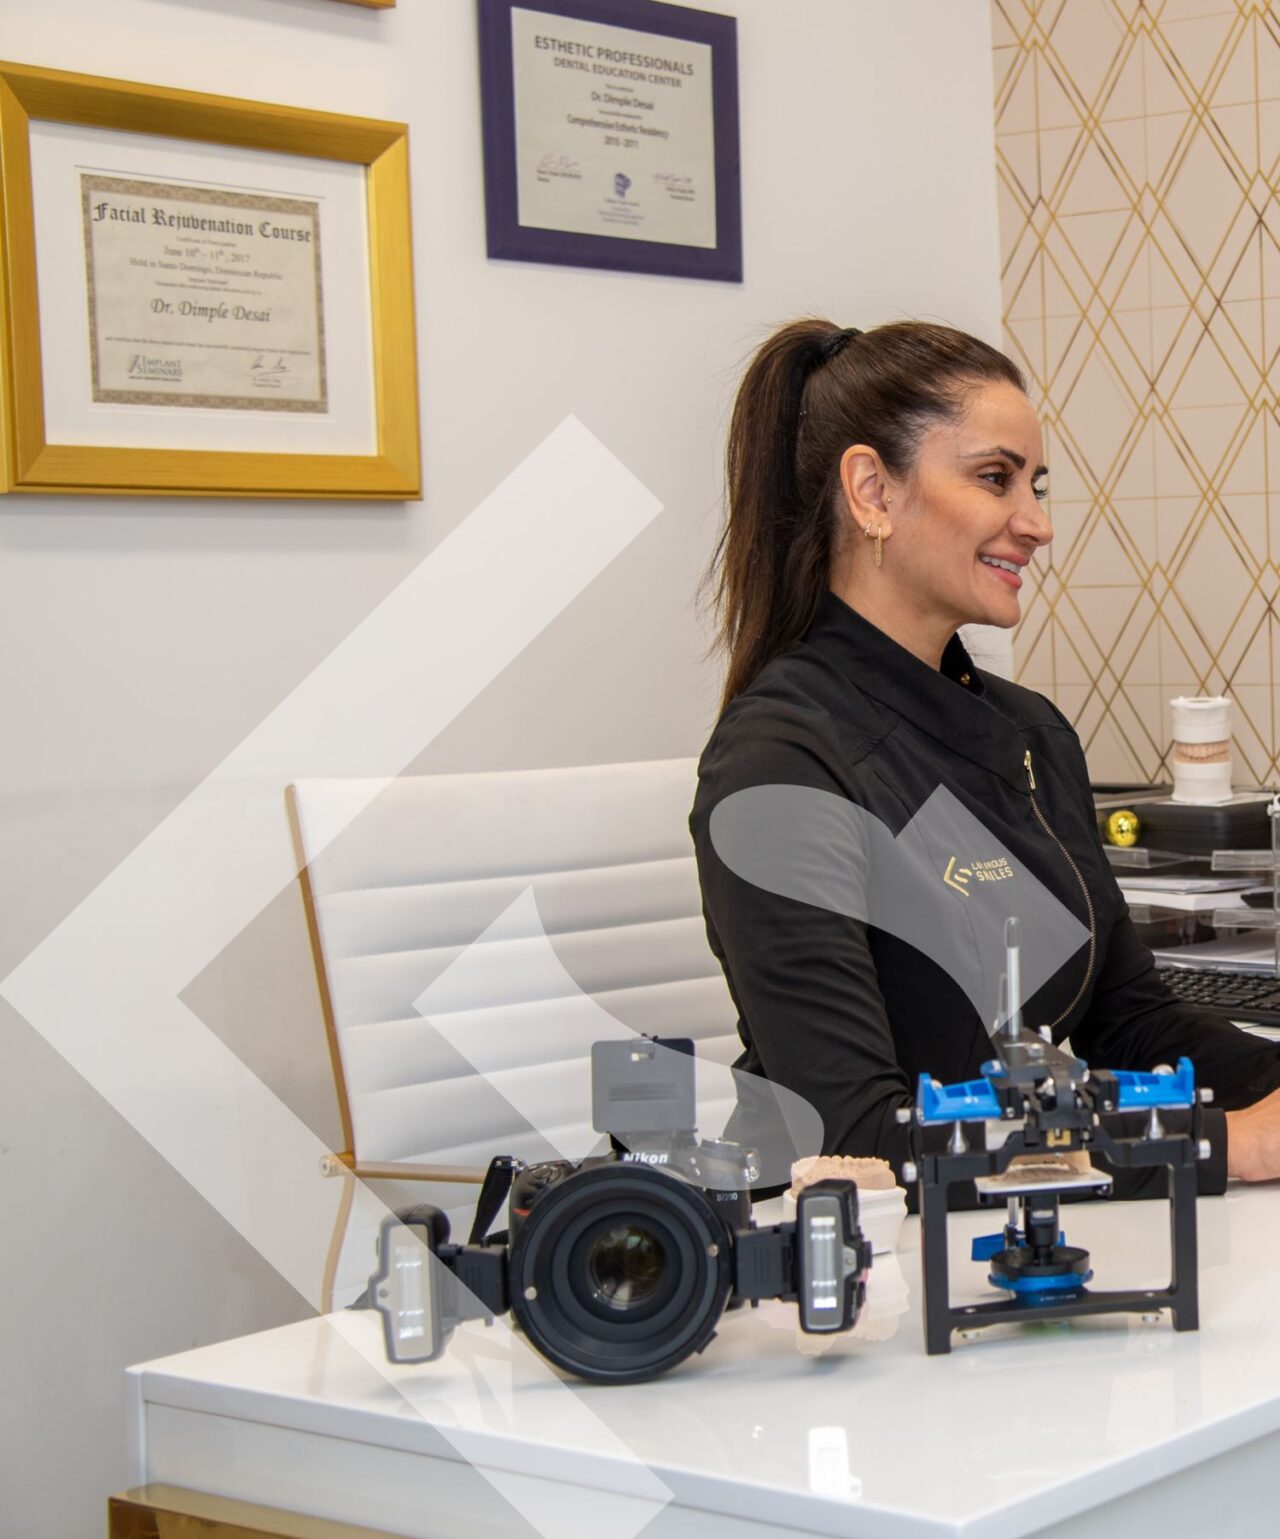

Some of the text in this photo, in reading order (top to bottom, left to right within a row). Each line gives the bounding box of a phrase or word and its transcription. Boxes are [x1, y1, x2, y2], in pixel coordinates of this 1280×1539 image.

[535, 35, 694, 76] ESTHETIC PROFESSIONALS
[553, 57, 682, 88] DENTAL EDUCATION CENTER
[92, 202, 312, 243] Facial Rejuvenation Course
[164, 246, 183, 257] June
[151, 299, 271, 323] Dr. Dimple Desai
[623, 1152, 669, 1164] Nikon
